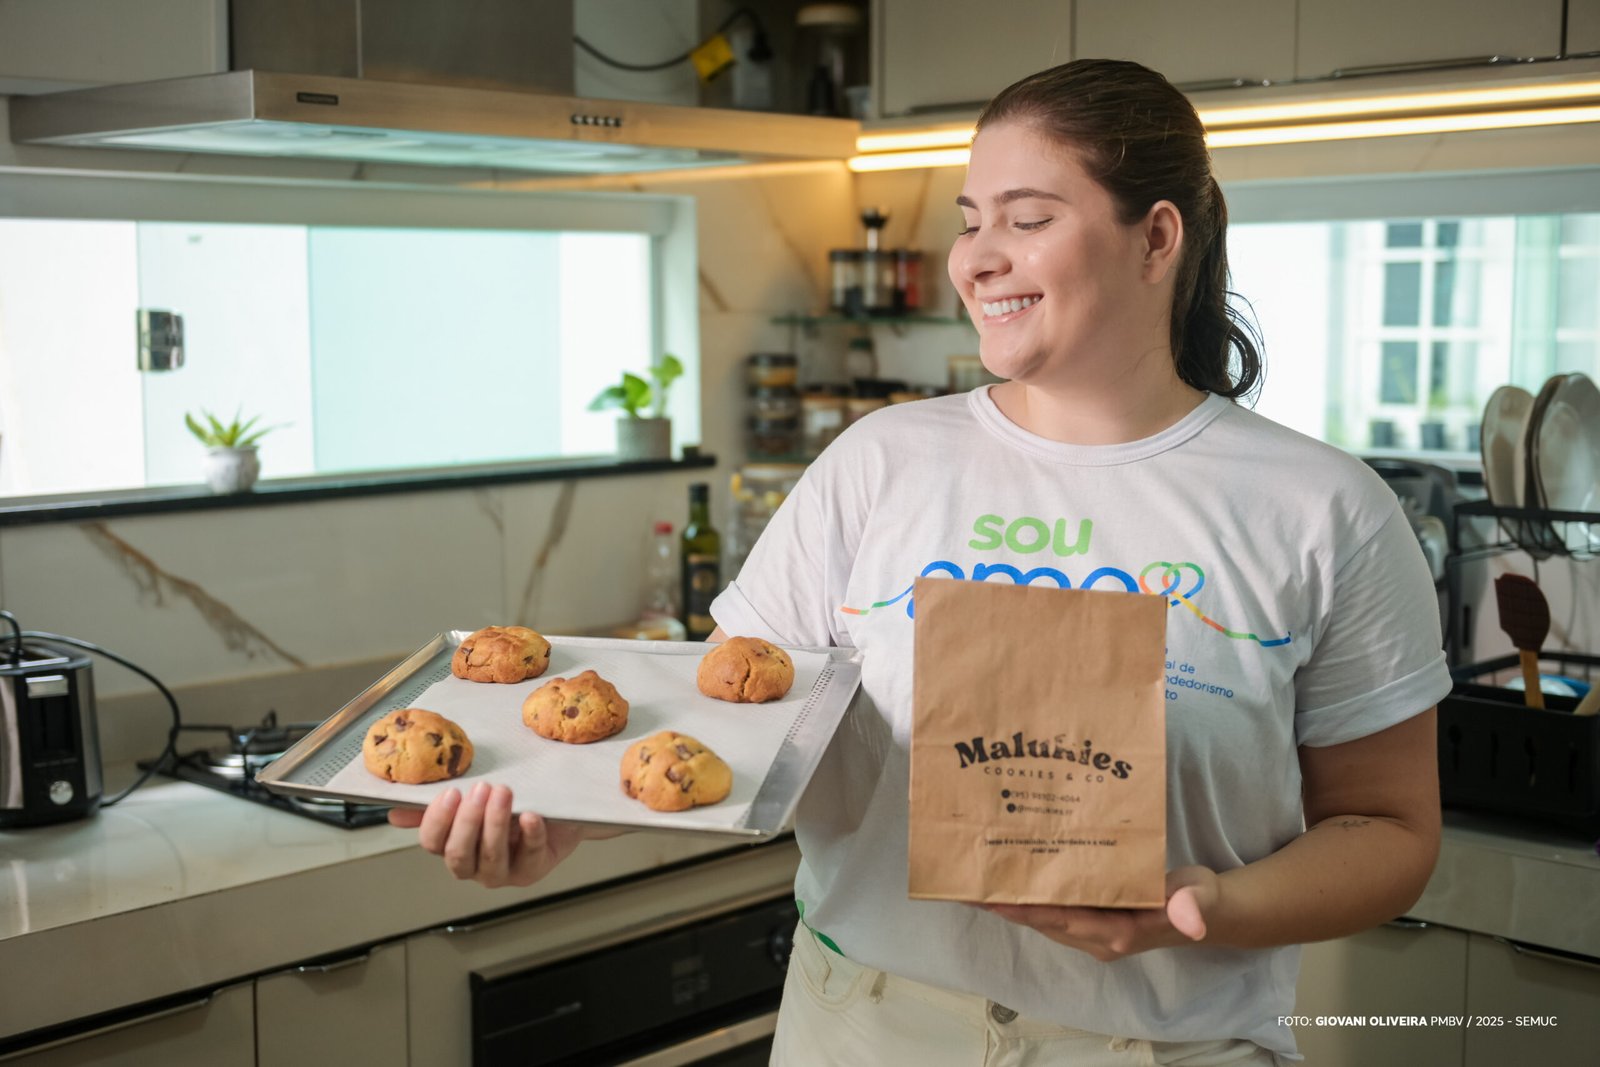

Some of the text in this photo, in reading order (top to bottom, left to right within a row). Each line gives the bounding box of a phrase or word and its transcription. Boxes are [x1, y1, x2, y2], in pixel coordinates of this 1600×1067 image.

[968, 514, 1093, 557] sou
[1179, 662, 1195, 673] de
[1165, 675, 1234, 698] ndedorismo
[984, 767, 1104, 783] COOKIES & CO
